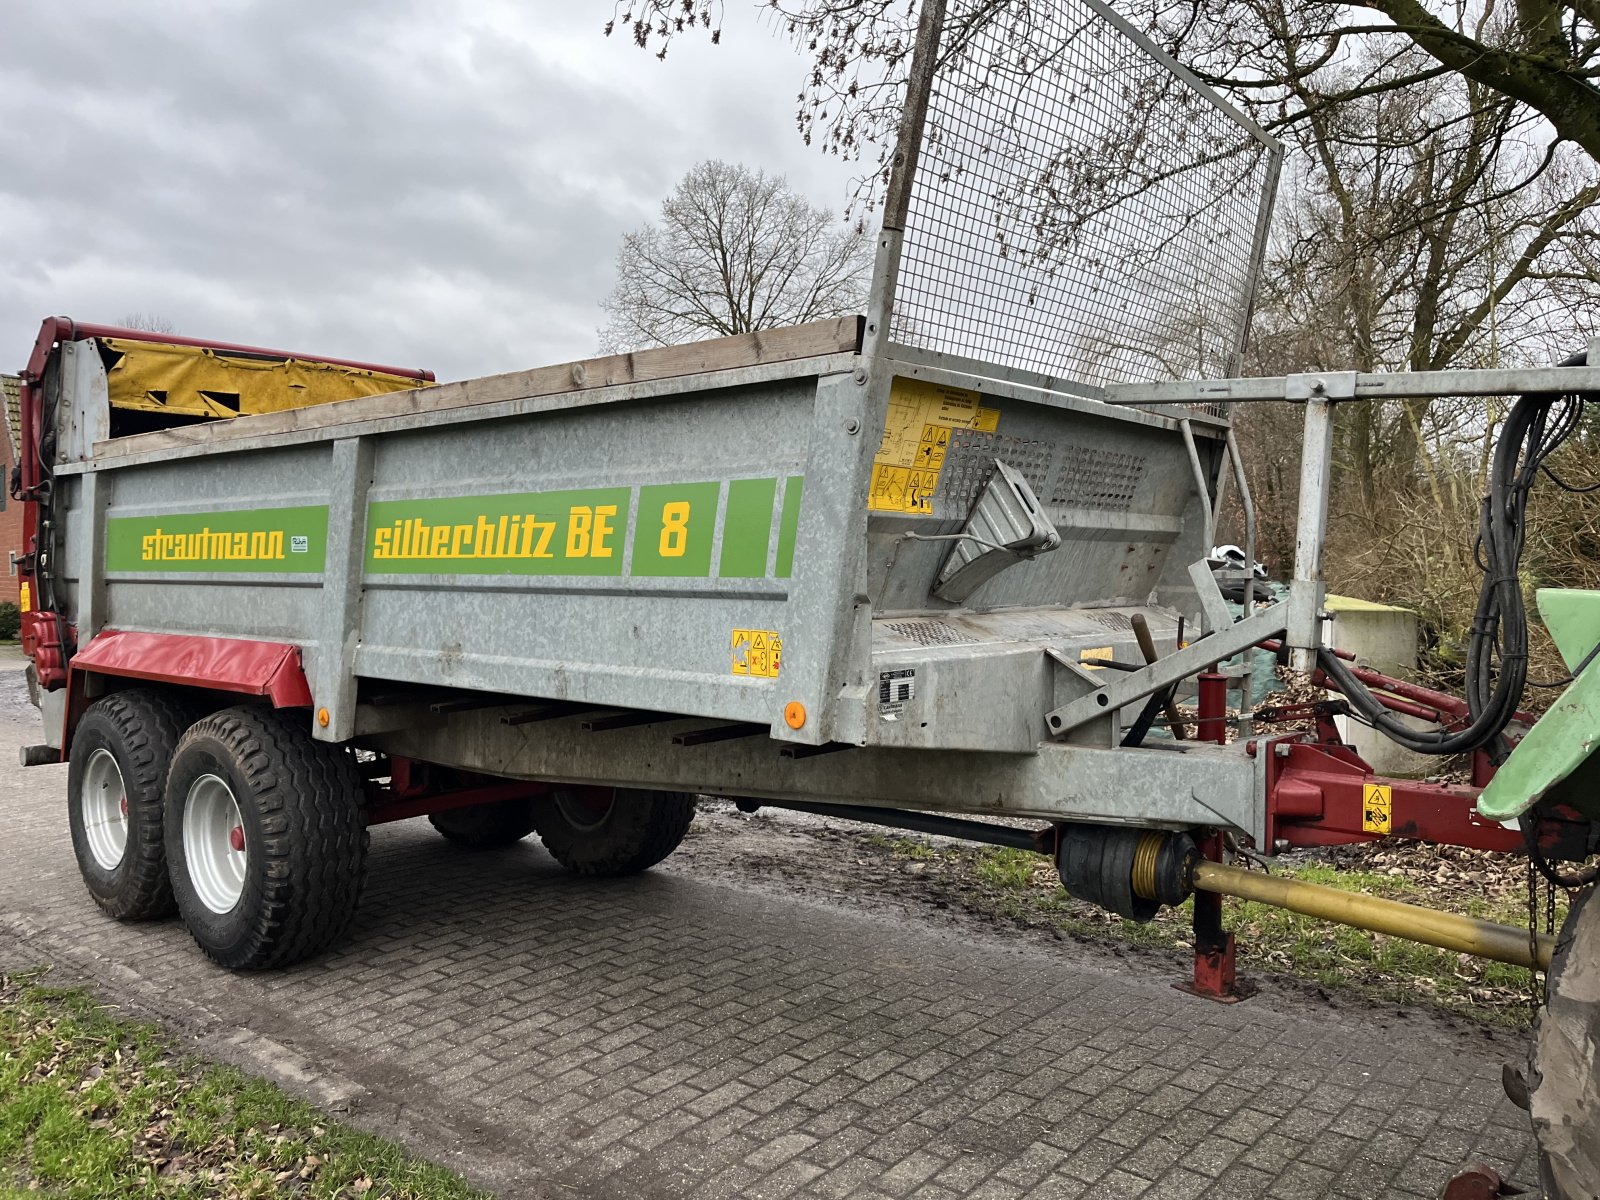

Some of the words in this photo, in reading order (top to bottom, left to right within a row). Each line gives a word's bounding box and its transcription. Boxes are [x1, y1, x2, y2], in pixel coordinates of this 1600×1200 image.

[142, 527, 285, 561] strautmann
[373, 514, 556, 559] silberblitz
[565, 504, 618, 558] BE
[658, 501, 691, 557] 8
